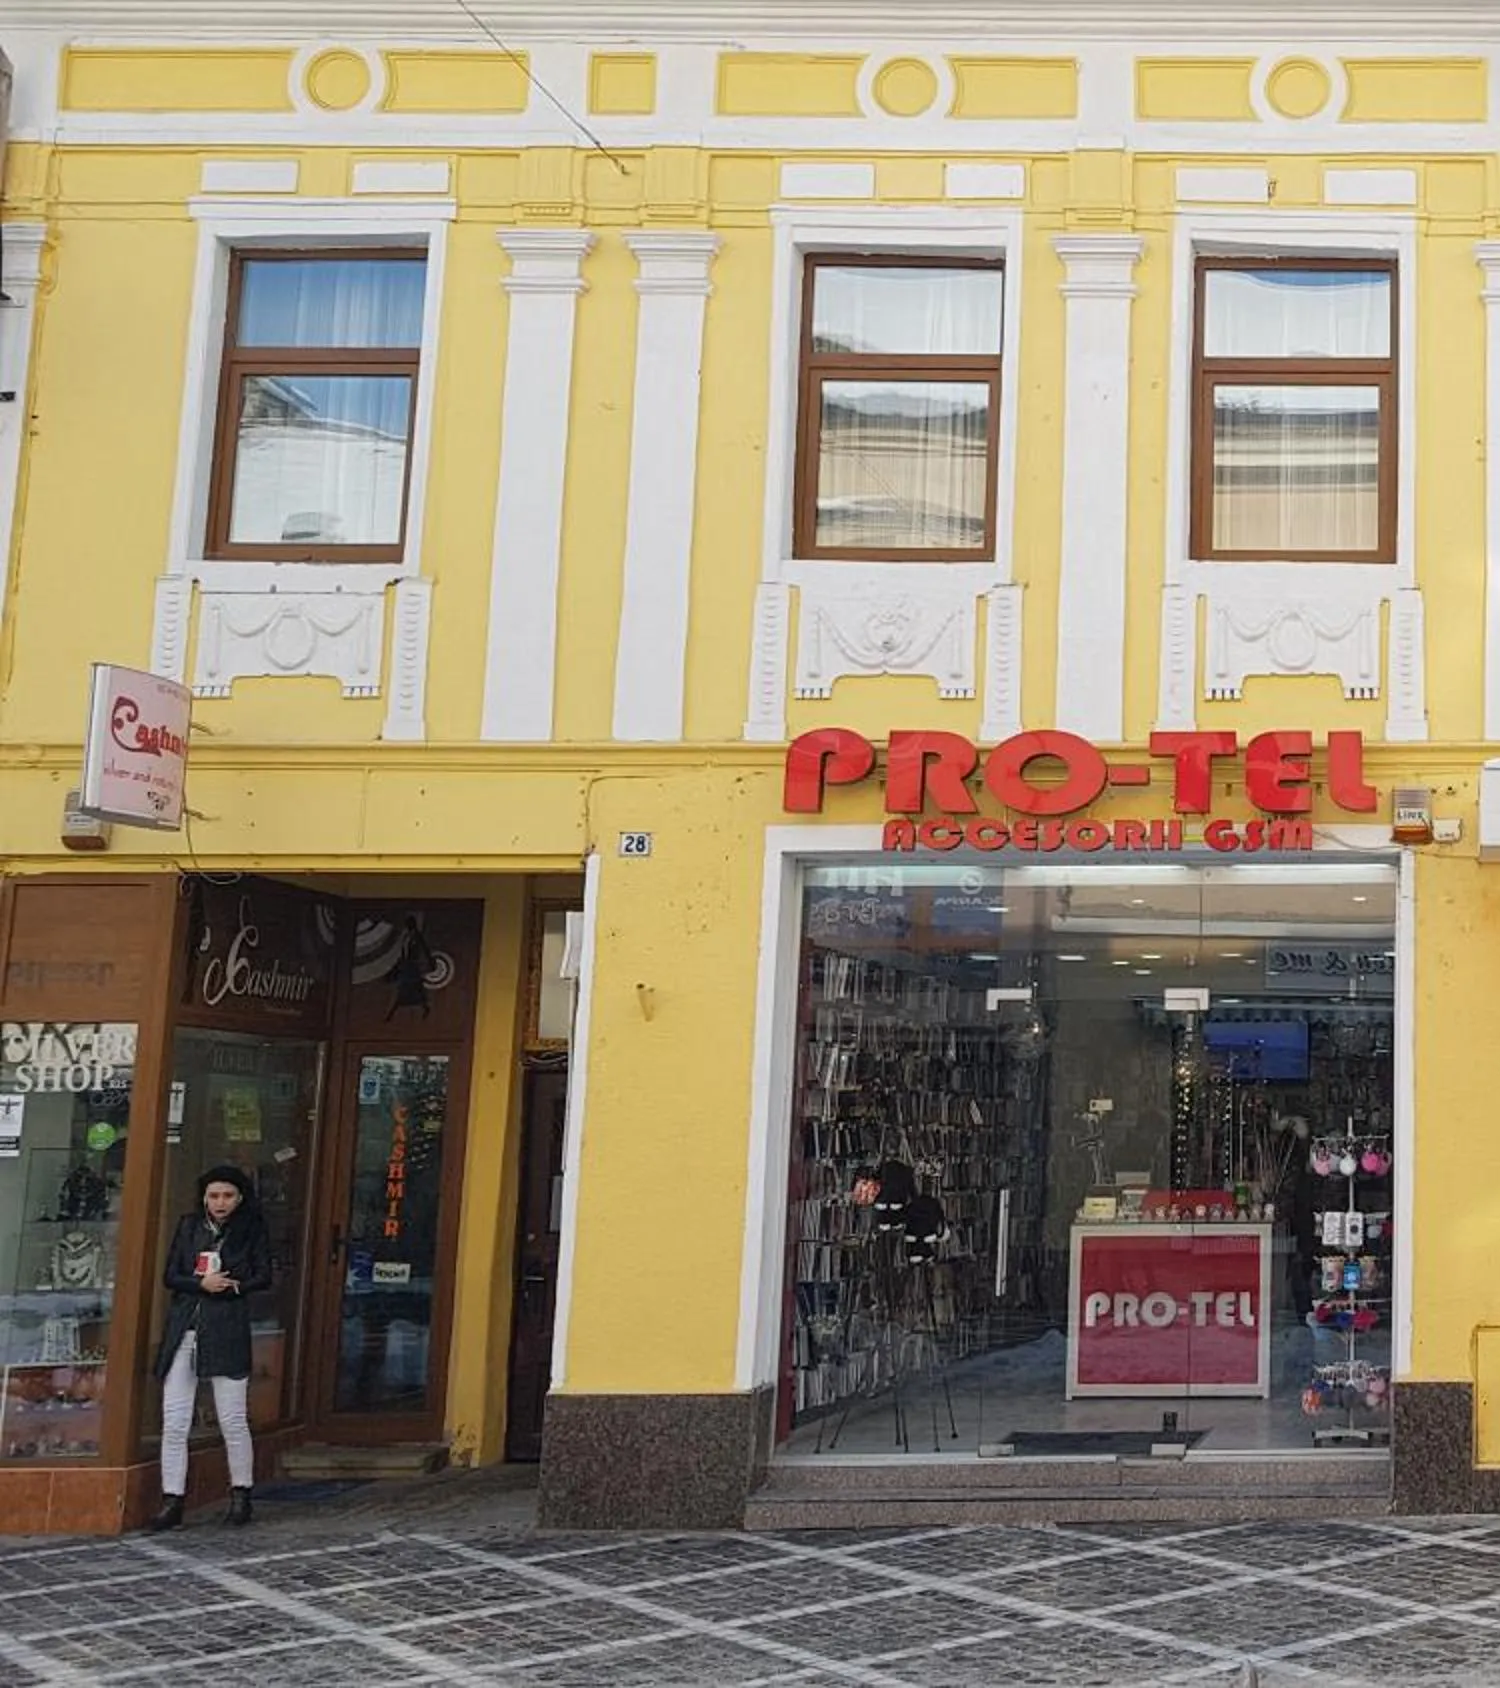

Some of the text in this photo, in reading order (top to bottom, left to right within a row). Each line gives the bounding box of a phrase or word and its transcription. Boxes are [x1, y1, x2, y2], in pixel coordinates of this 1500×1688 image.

[783, 728, 1378, 815] PRO-TEL
[624, 835, 646, 853] 28
[882, 818, 1314, 853] ACCESORII GSM
[4, 1031, 136, 1064] SILVER
[15, 1064, 113, 1092] SHOP
[384, 1103, 410, 1238] CASHMIR
[1085, 1291, 1256, 1329] PRO-TEL
